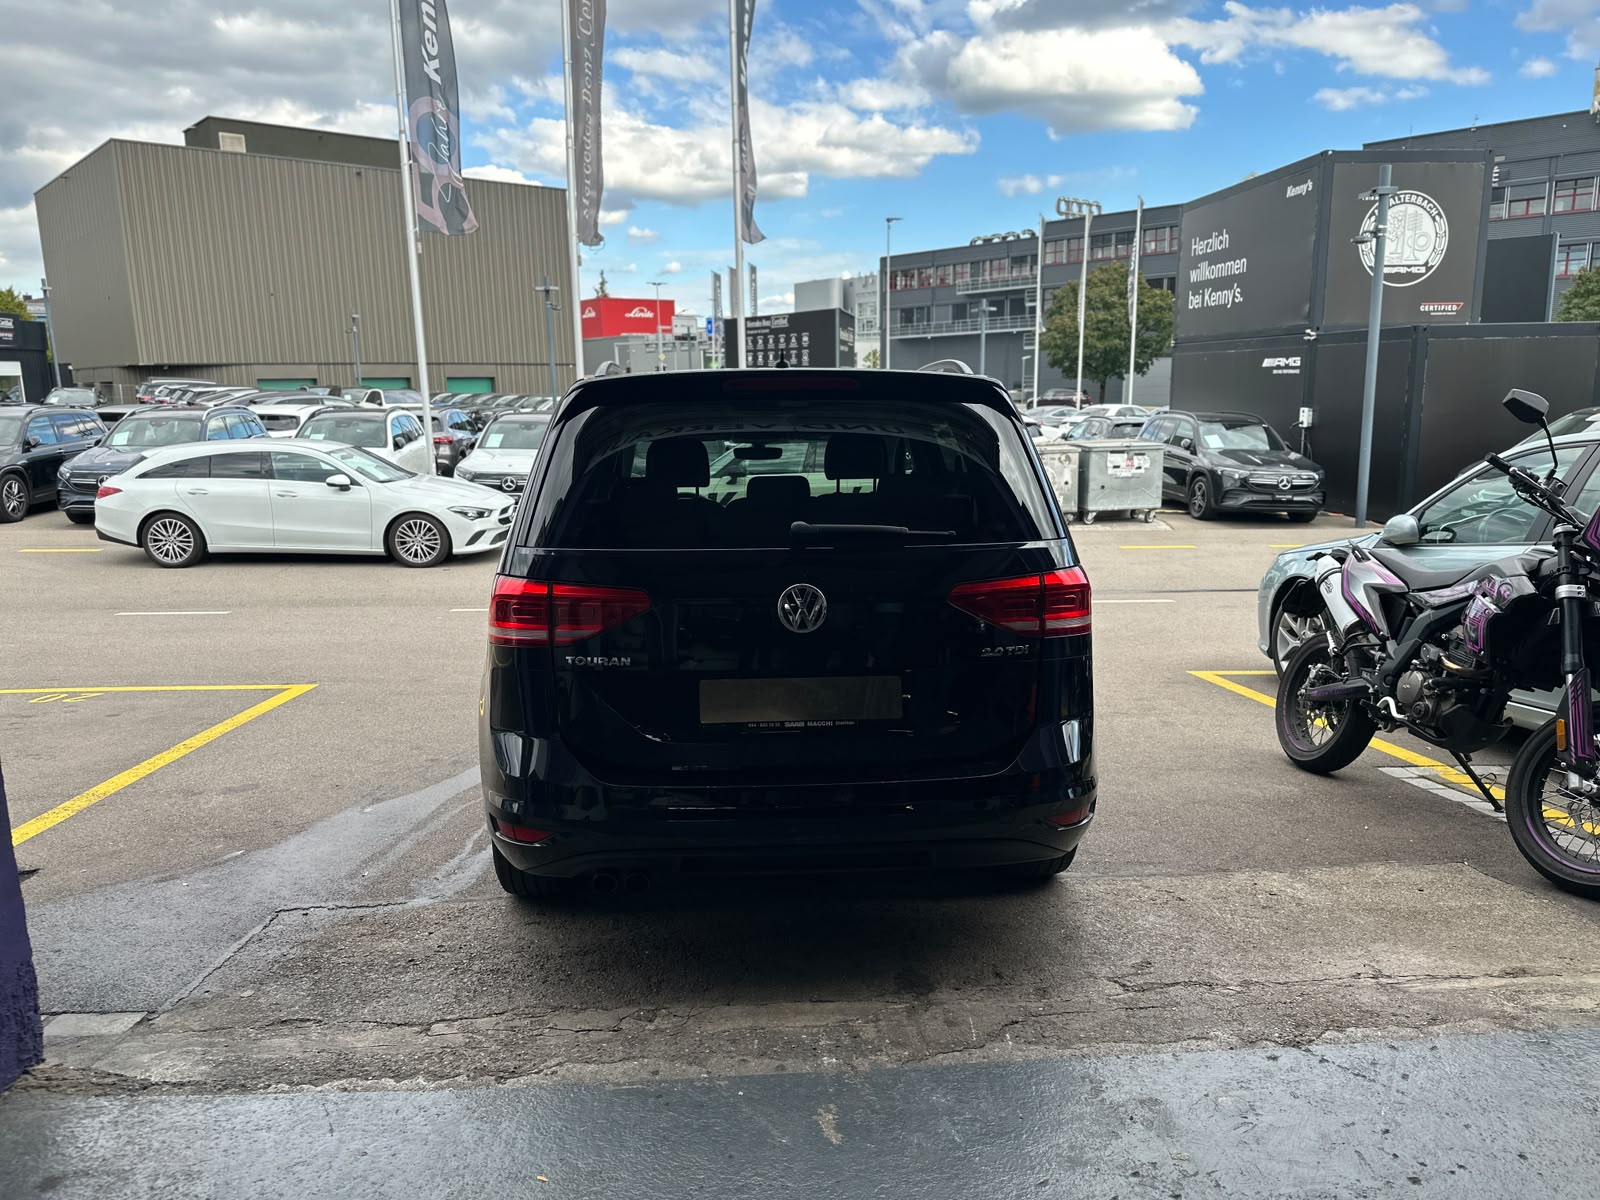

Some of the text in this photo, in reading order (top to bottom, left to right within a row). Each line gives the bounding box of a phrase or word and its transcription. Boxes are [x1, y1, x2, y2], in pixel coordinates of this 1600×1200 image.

[421, 0, 442, 86] Ken
[1286, 179, 1313, 198] Kenny's
[1376, 194, 1438, 217] ALTERBACH
[1191, 228, 1229, 256] Herzlich
[1189, 257, 1247, 283] willkommen
[1391, 266, 1427, 274] AMG
[1188, 282, 1243, 309] bei Kenny's.
[1420, 304, 1459, 312] CERTIFIED
[1271, 356, 1302, 368] AMG
[565, 655, 631, 667] TOURAN
